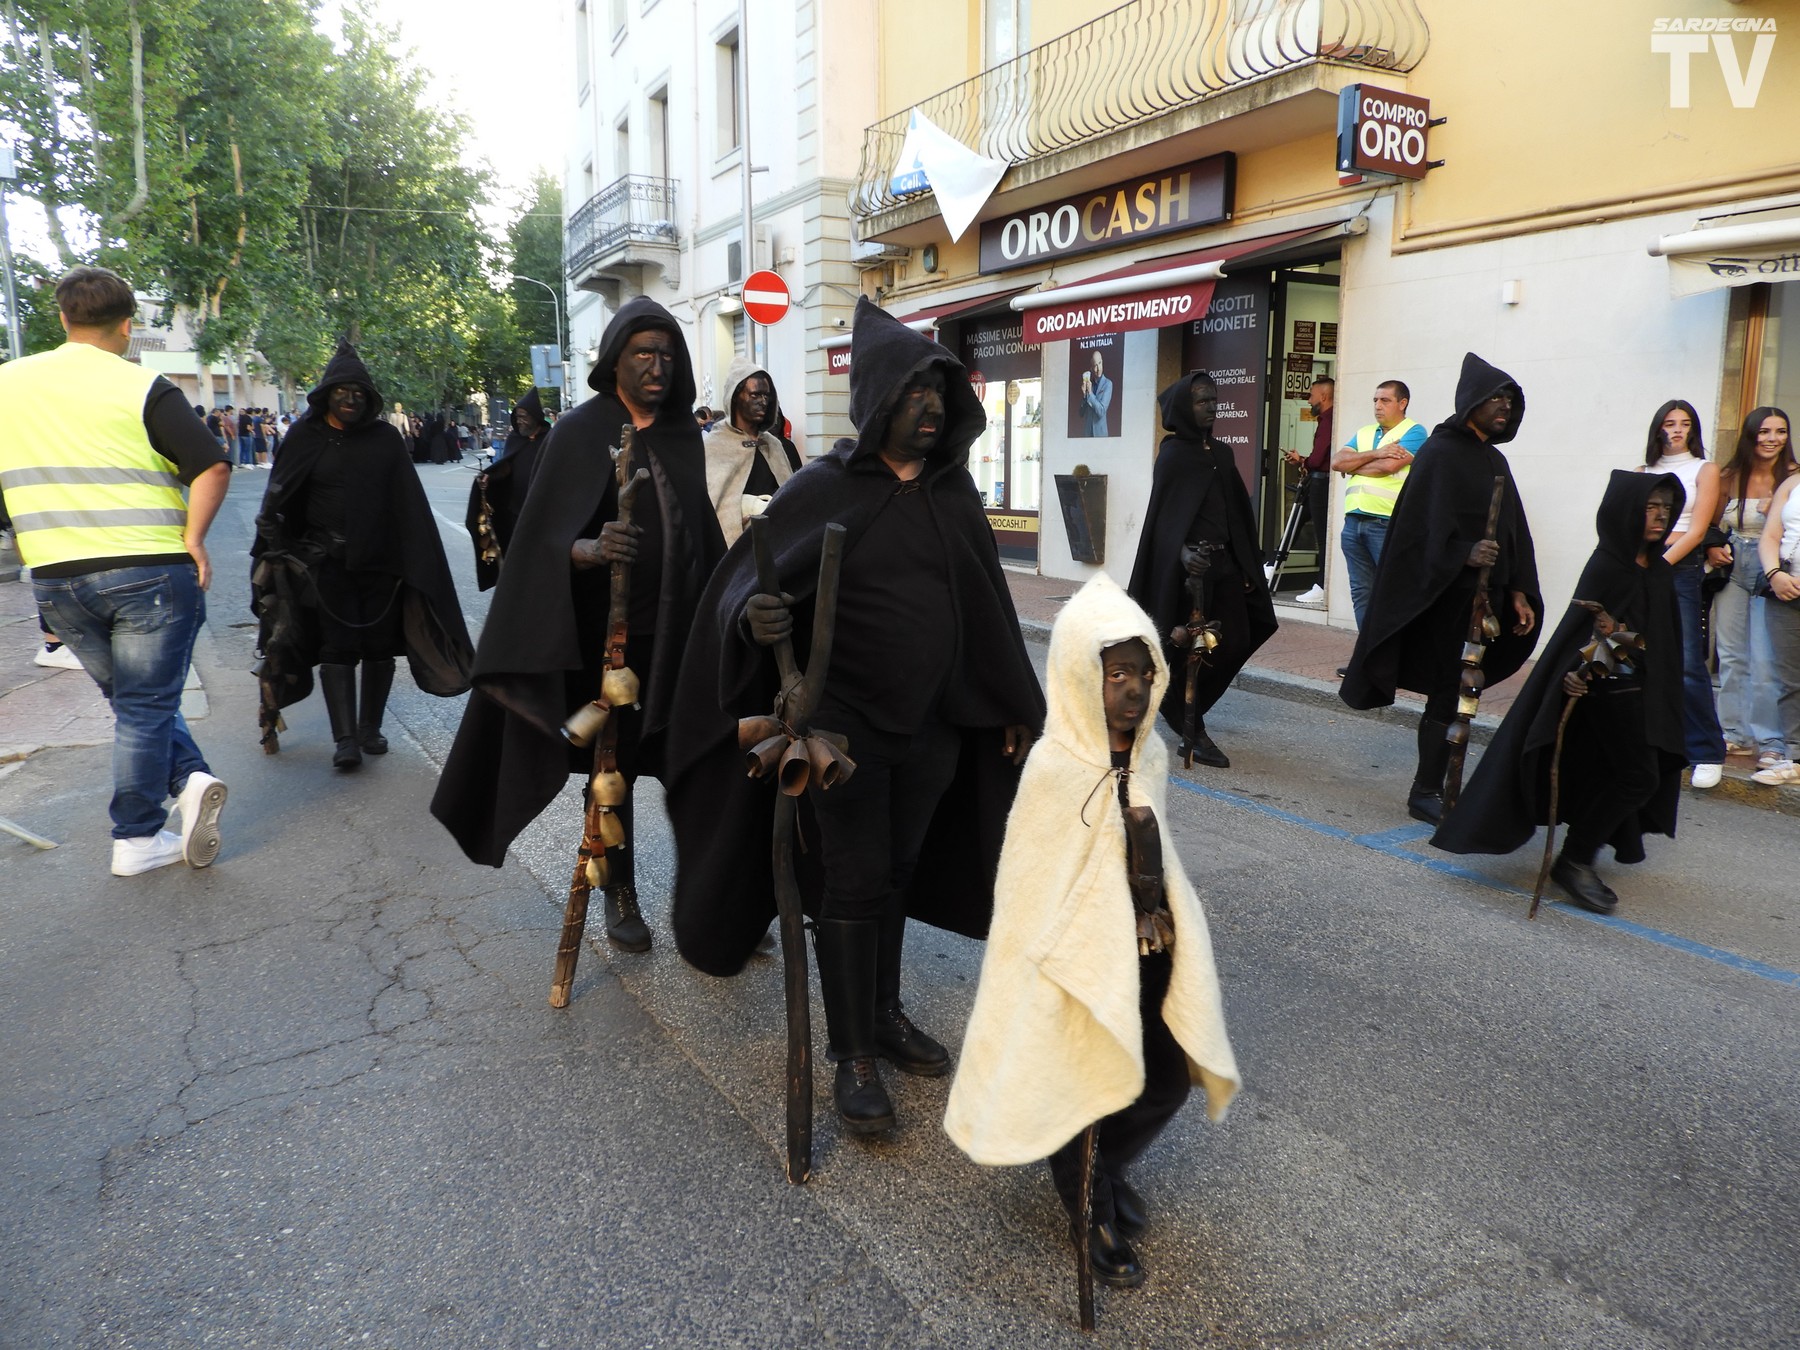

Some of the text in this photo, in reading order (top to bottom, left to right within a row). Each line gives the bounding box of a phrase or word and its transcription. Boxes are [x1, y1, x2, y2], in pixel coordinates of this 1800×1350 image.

[1363, 97, 1427, 128] COMPRO
[1360, 119, 1425, 165] ORO
[900, 173, 922, 191] Cell.
[1758, 253, 1800, 273] ott
[1206, 294, 1254, 314] NGOTTI
[1037, 294, 1192, 334] ORO DA INVESTIMENTO
[1193, 313, 1257, 335] E MONETE
[966, 326, 1023, 345] MASSIME VALU
[1096, 337, 1113, 347] ITALIA
[973, 346, 995, 359] PAGO
[996, 344, 1005, 356] IN
[1208, 368, 1246, 379] QUOTAZIONI
[1216, 377, 1236, 386] TEMPO
[1237, 375, 1256, 384] REALE
[1287, 374, 1311, 390] 850
[1230, 402, 1235, 410] E
